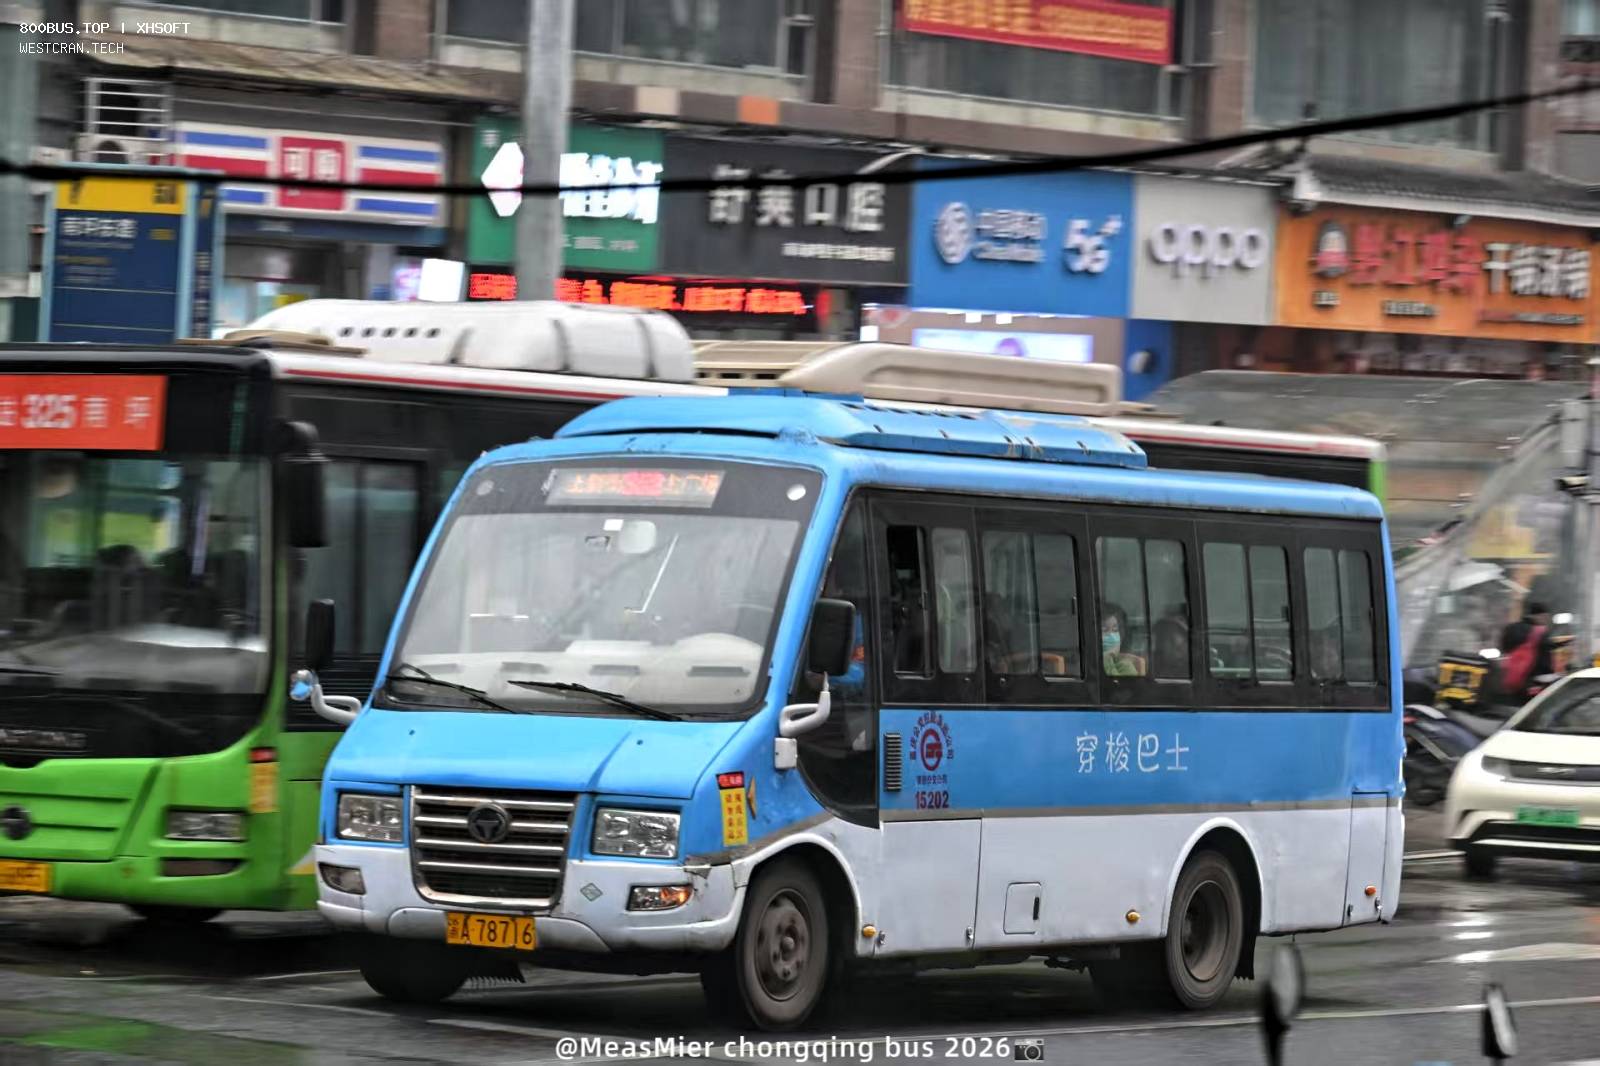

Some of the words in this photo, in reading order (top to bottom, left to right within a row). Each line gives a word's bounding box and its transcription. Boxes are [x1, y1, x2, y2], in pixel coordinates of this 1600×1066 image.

[1076, 730, 1190, 774] 穿梭巴士
[915, 790, 950, 810] 15202
